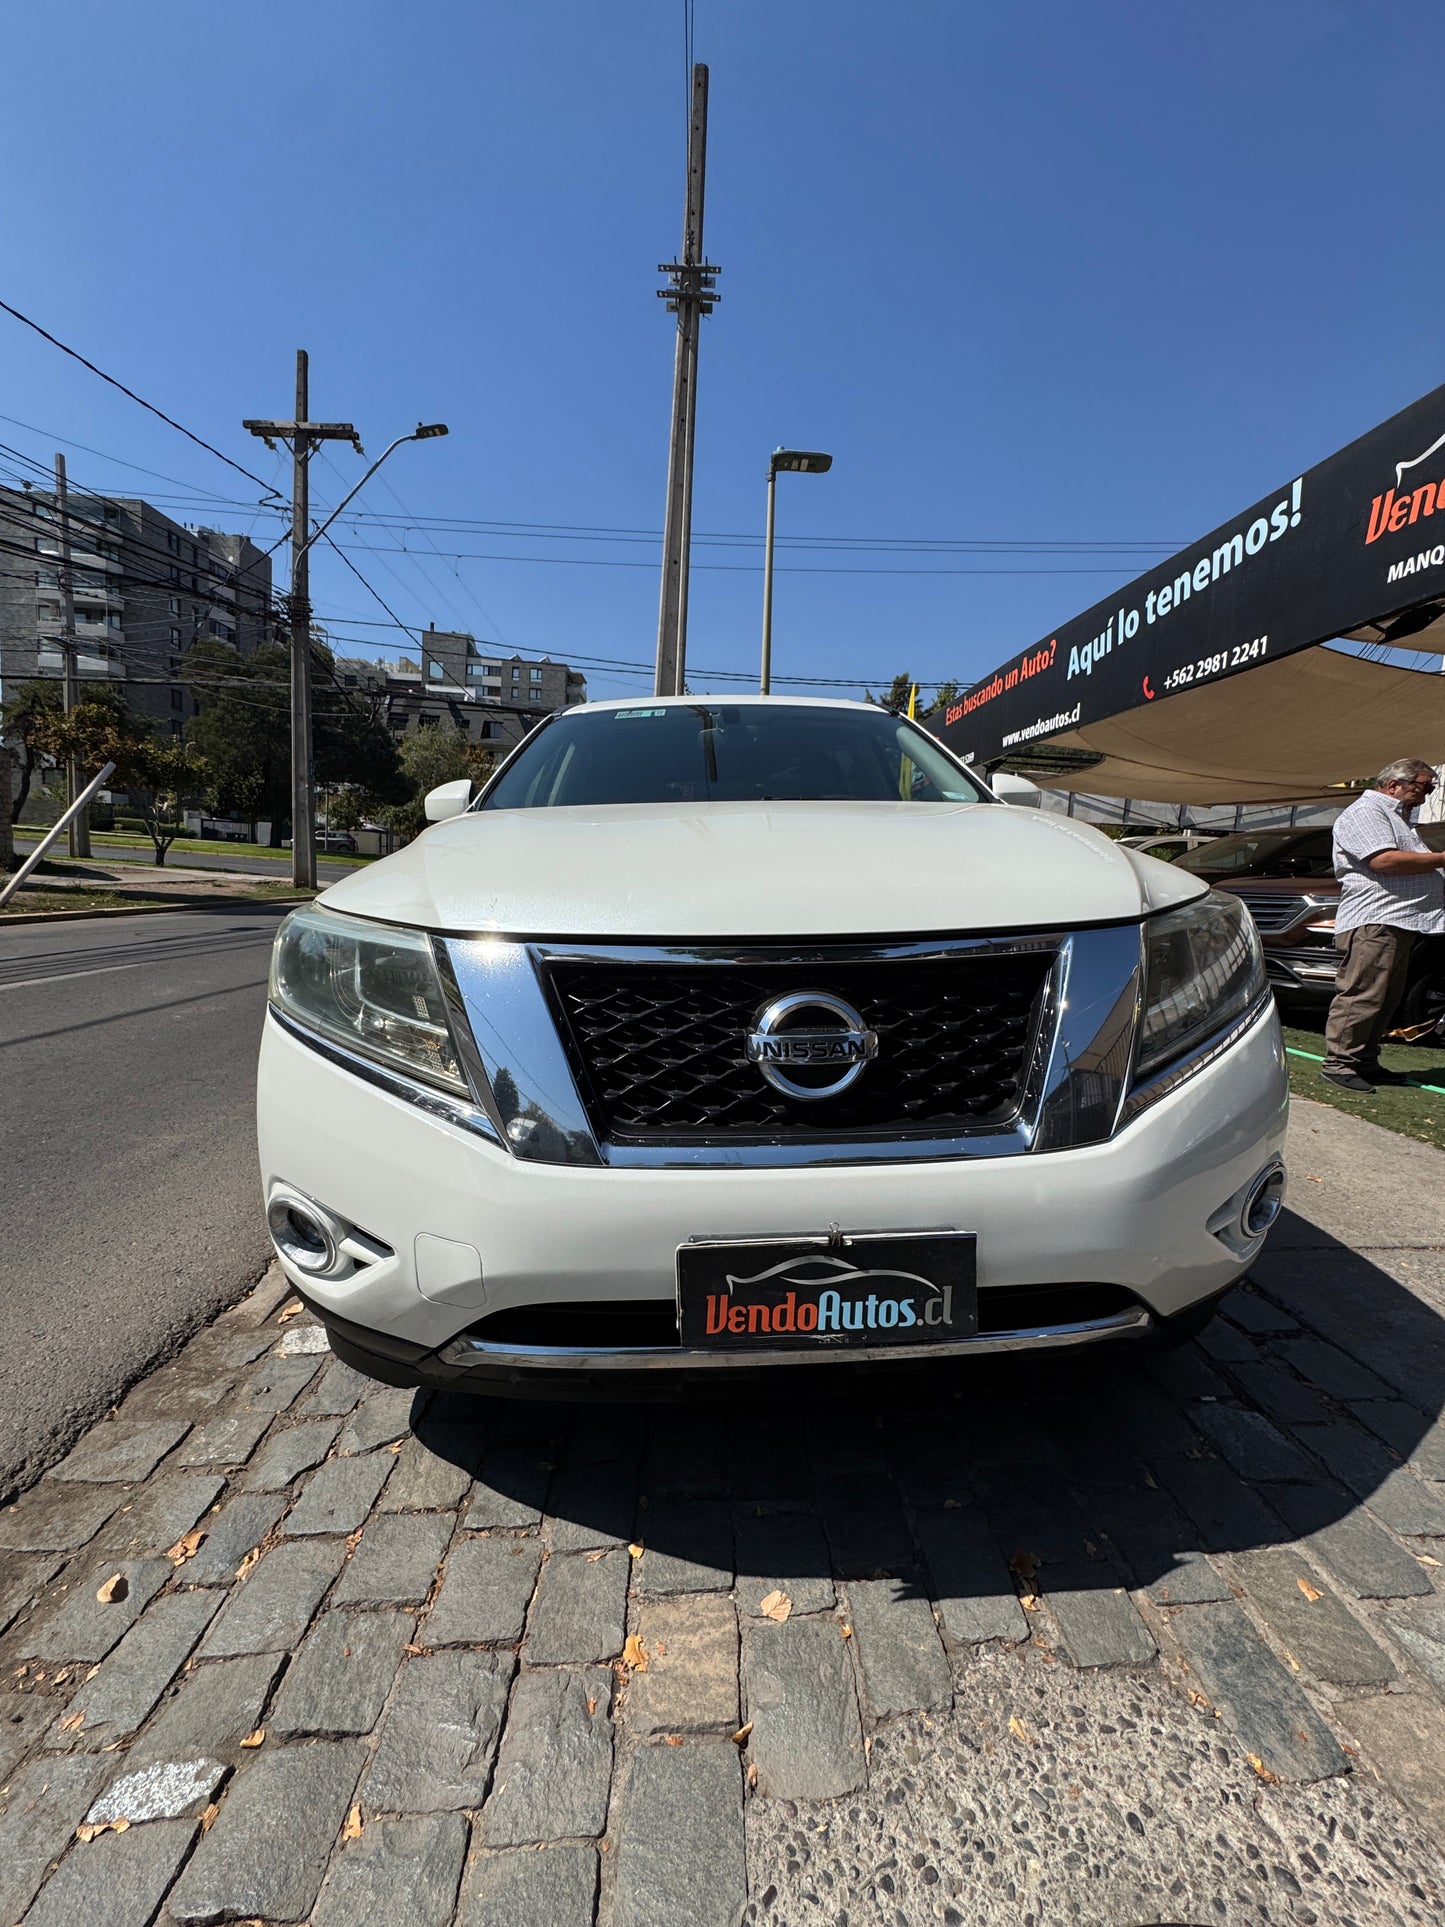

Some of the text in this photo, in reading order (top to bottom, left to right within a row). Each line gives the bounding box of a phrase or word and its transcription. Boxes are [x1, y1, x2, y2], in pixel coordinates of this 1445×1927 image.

[1066, 477, 1303, 681] Aquí lo tenemos!
[945, 639, 1057, 727] Estas buscando un Auto?
[1163, 635, 1268, 690] +562 2981 2241
[1002, 702, 1081, 748] www.vendoautos.cl
[763, 1039, 865, 1058] NISSAN
[706, 1285, 953, 1334] VendoAutos.cl
